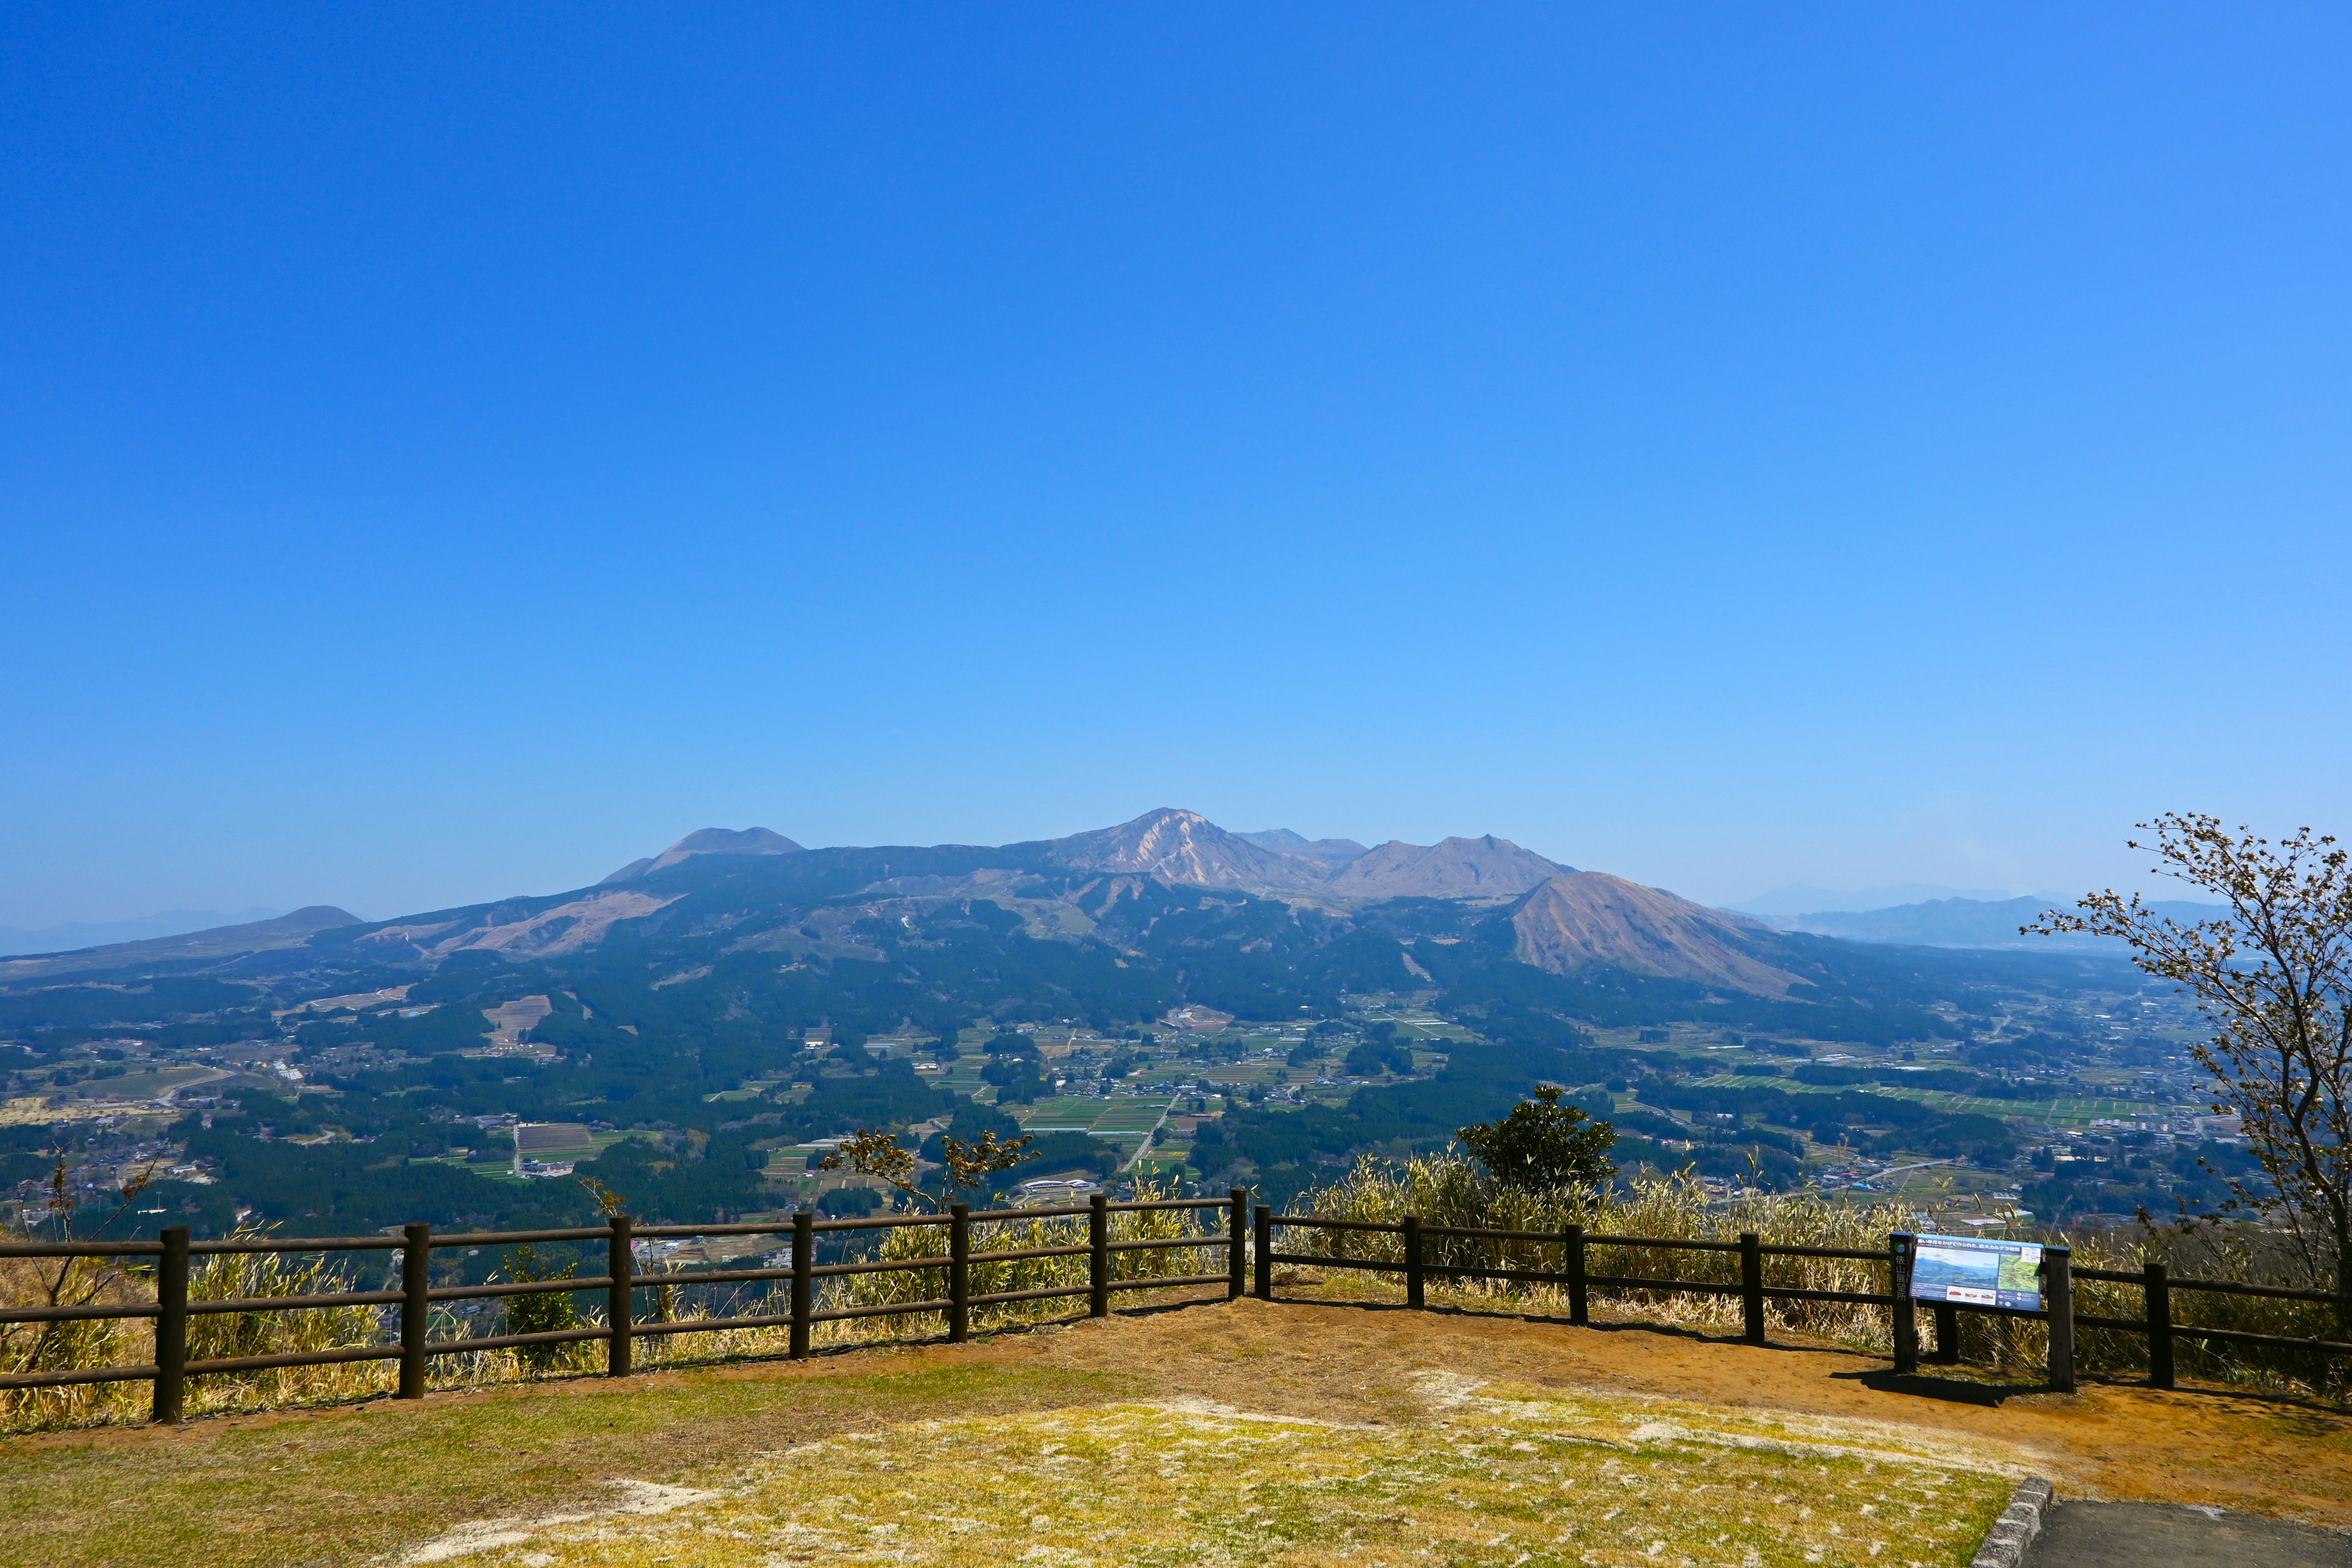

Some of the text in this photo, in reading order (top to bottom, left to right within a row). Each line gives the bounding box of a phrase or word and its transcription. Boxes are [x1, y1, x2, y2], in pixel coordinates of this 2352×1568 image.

[1895, 1255, 1906, 1302] 俵山展望所
